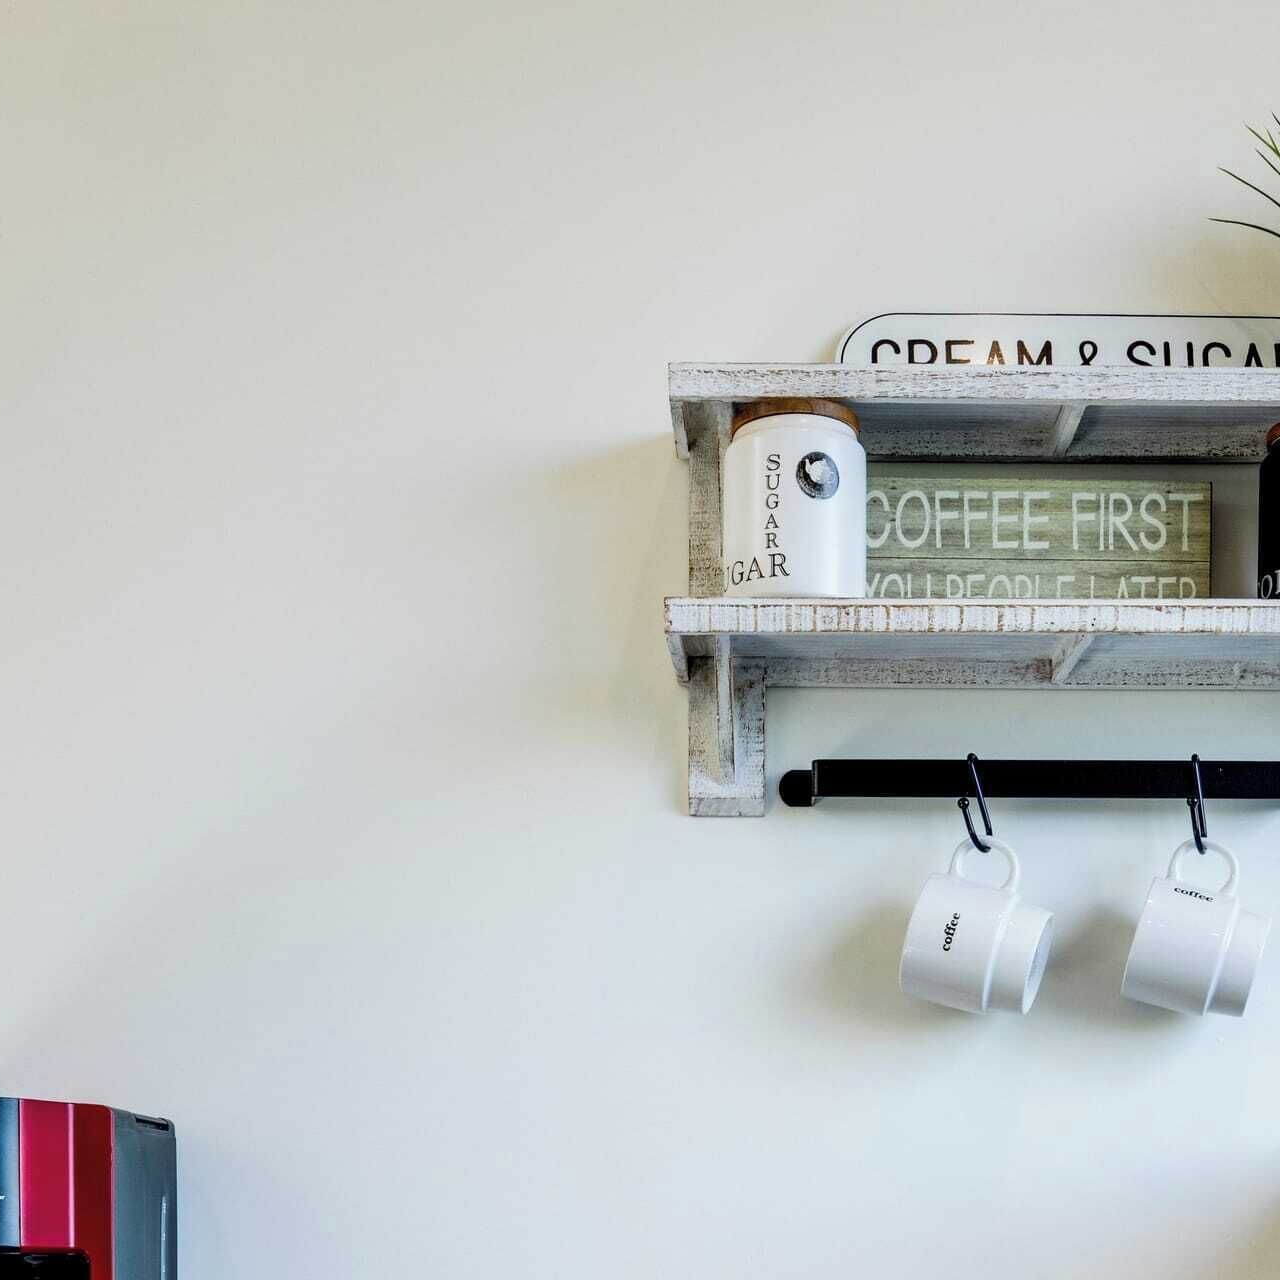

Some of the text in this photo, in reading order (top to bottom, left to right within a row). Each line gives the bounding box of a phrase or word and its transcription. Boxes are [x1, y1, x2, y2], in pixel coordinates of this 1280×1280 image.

[764, 453, 781, 549] SUGAR
[866, 490, 1203, 551] COFFEE FIRST
[1174, 887, 1214, 902] coffee
[943, 912, 960, 951] coffee
